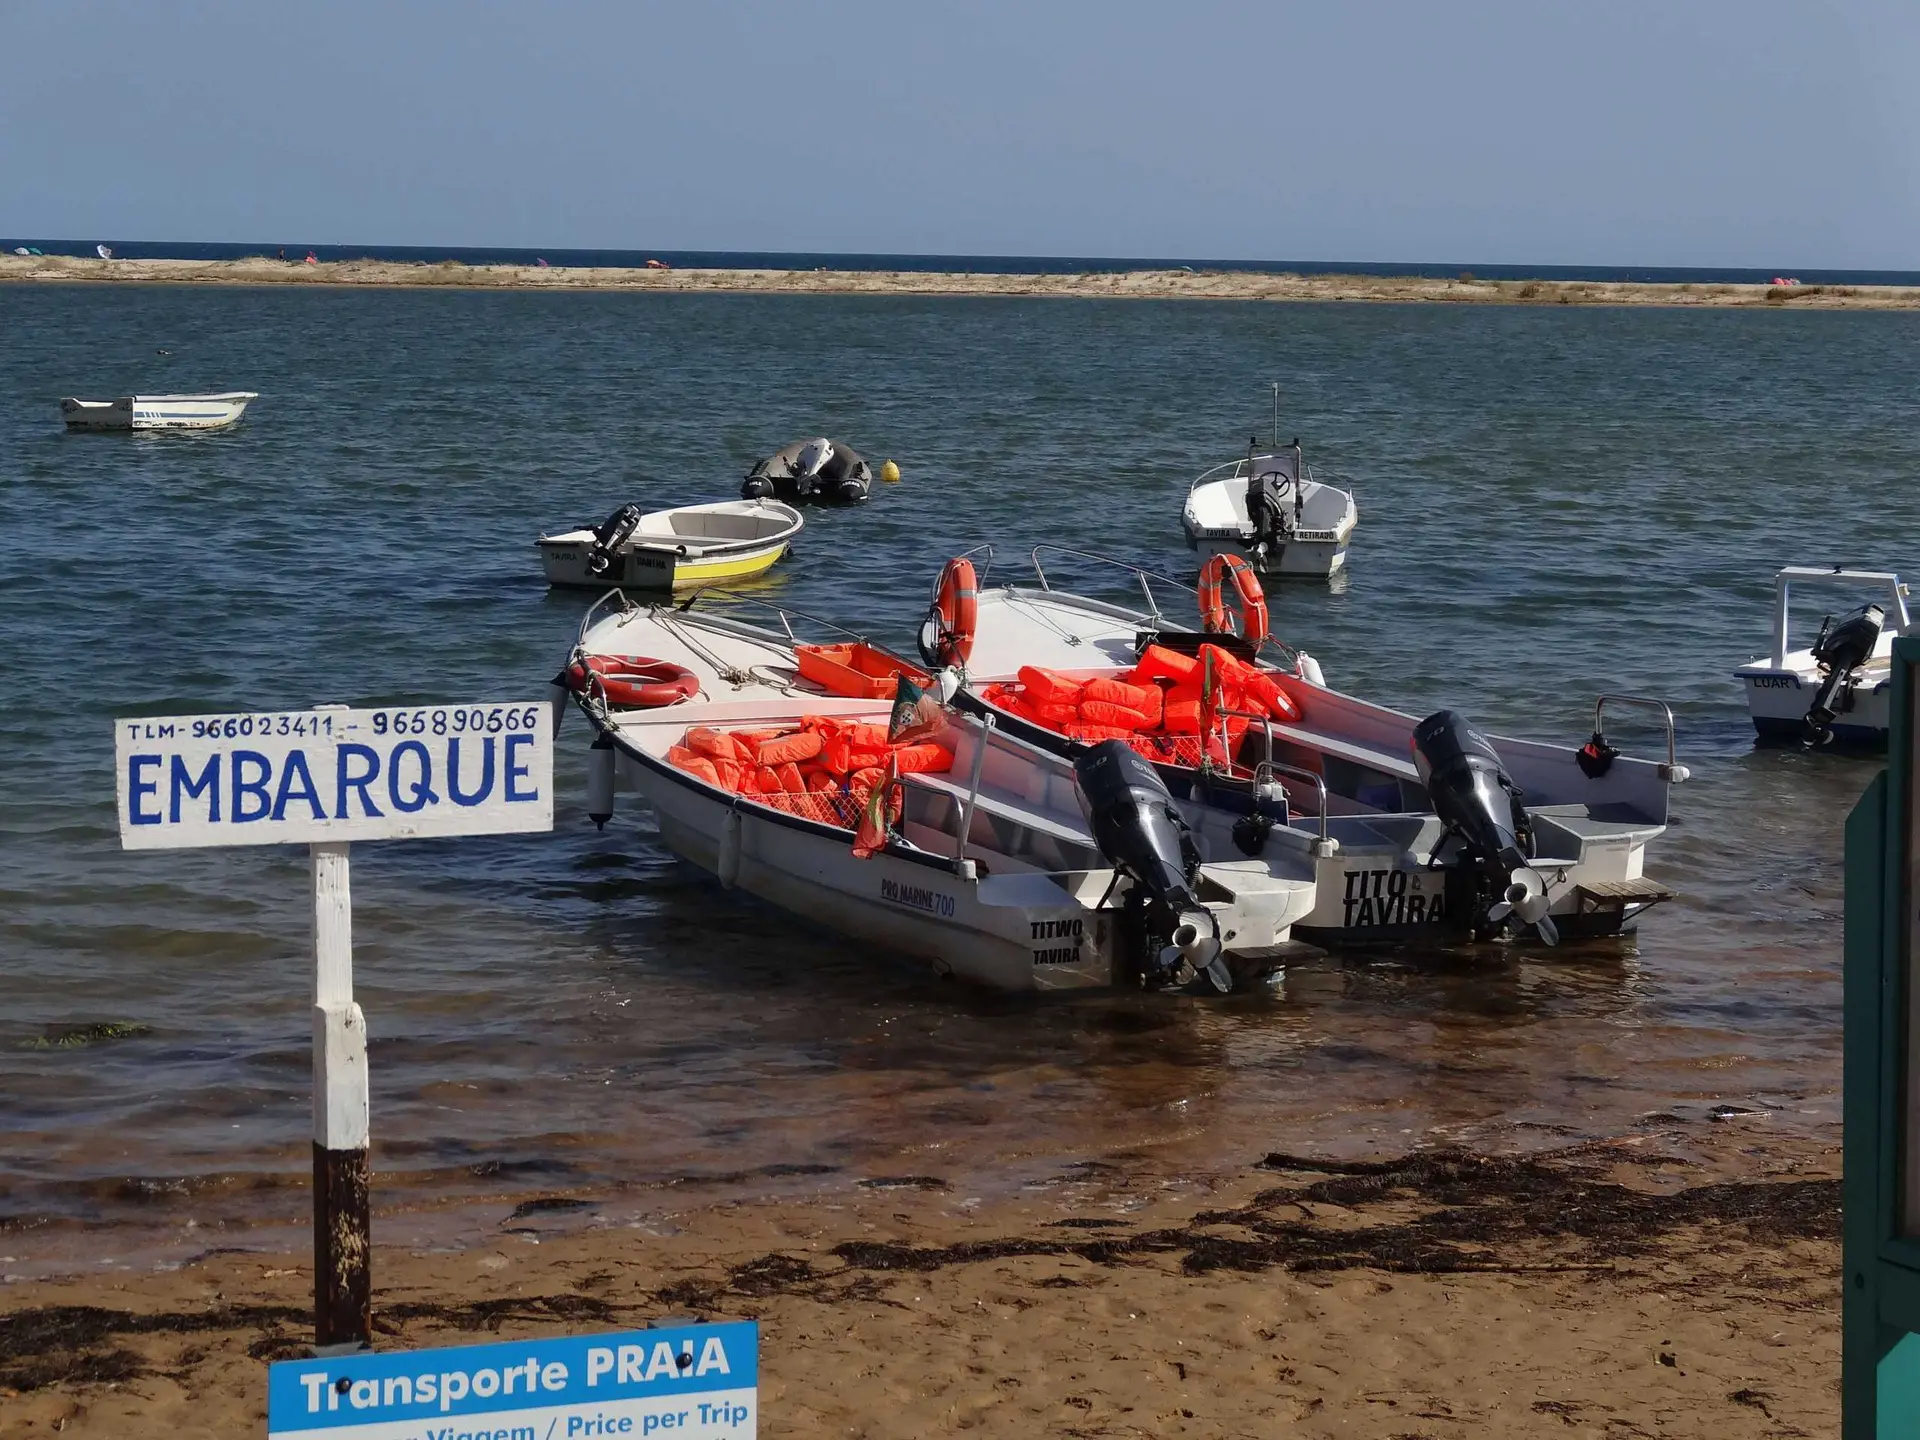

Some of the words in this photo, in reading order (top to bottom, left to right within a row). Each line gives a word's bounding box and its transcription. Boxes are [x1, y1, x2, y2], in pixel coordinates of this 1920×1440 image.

[1206, 529, 1231, 537] TAVIRA
[1753, 677, 1790, 689] LUAR
[372, 707, 539, 736] 965890566
[128, 733, 539, 825] EMBARQUE
[881, 878, 898, 899] PRO
[900, 884, 934, 909] MARINE
[935, 893, 955, 917] 700
[1344, 870, 1407, 898] TITO
[1343, 894, 1445, 926] TAVIRA
[1031, 918, 1083, 940] TITWO
[1033, 947, 1080, 965] TAVIRA
[300, 1356, 569, 1413] Transporte
[586, 1337, 731, 1387] PRAIA
[567, 1412, 633, 1437] Price
[643, 1411, 689, 1436] per
[697, 1401, 748, 1427] Trip
